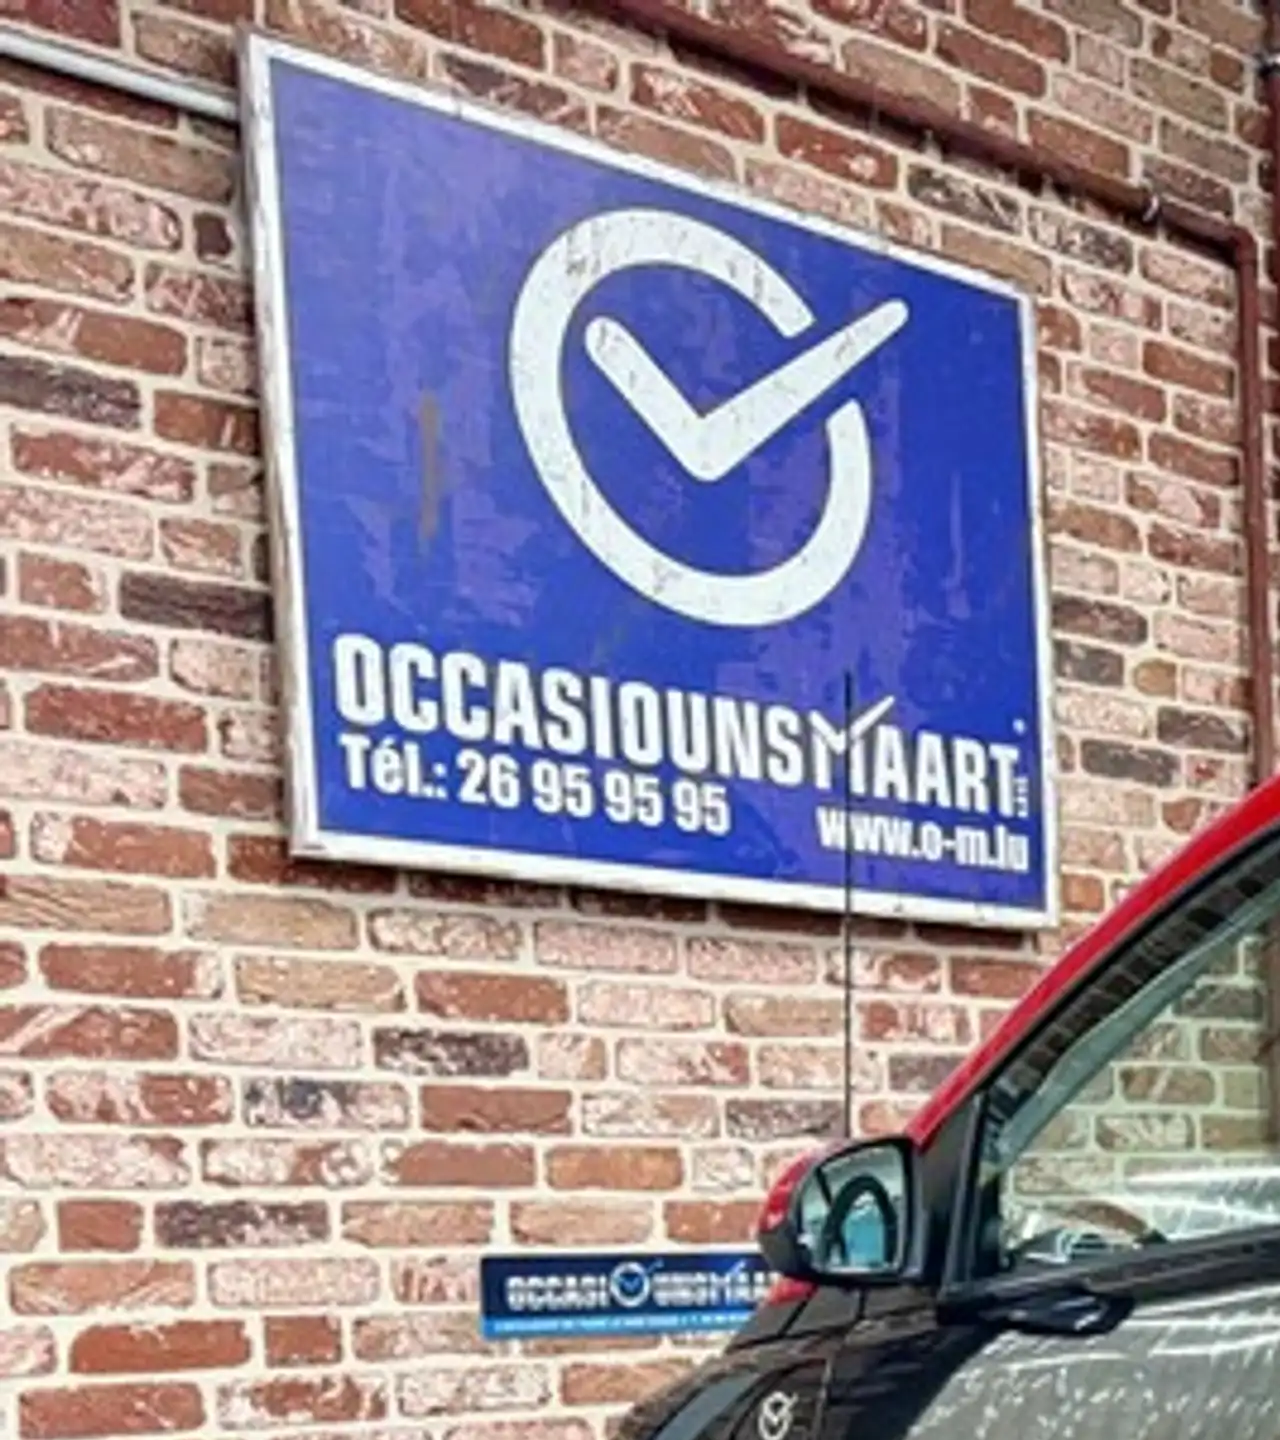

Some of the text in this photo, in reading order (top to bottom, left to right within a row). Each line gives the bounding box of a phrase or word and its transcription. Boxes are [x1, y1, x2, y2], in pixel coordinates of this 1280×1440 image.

[339, 732, 731, 837] Tél.: 26 95 95 95
[815, 805, 1030, 873] www.o-m.lu
